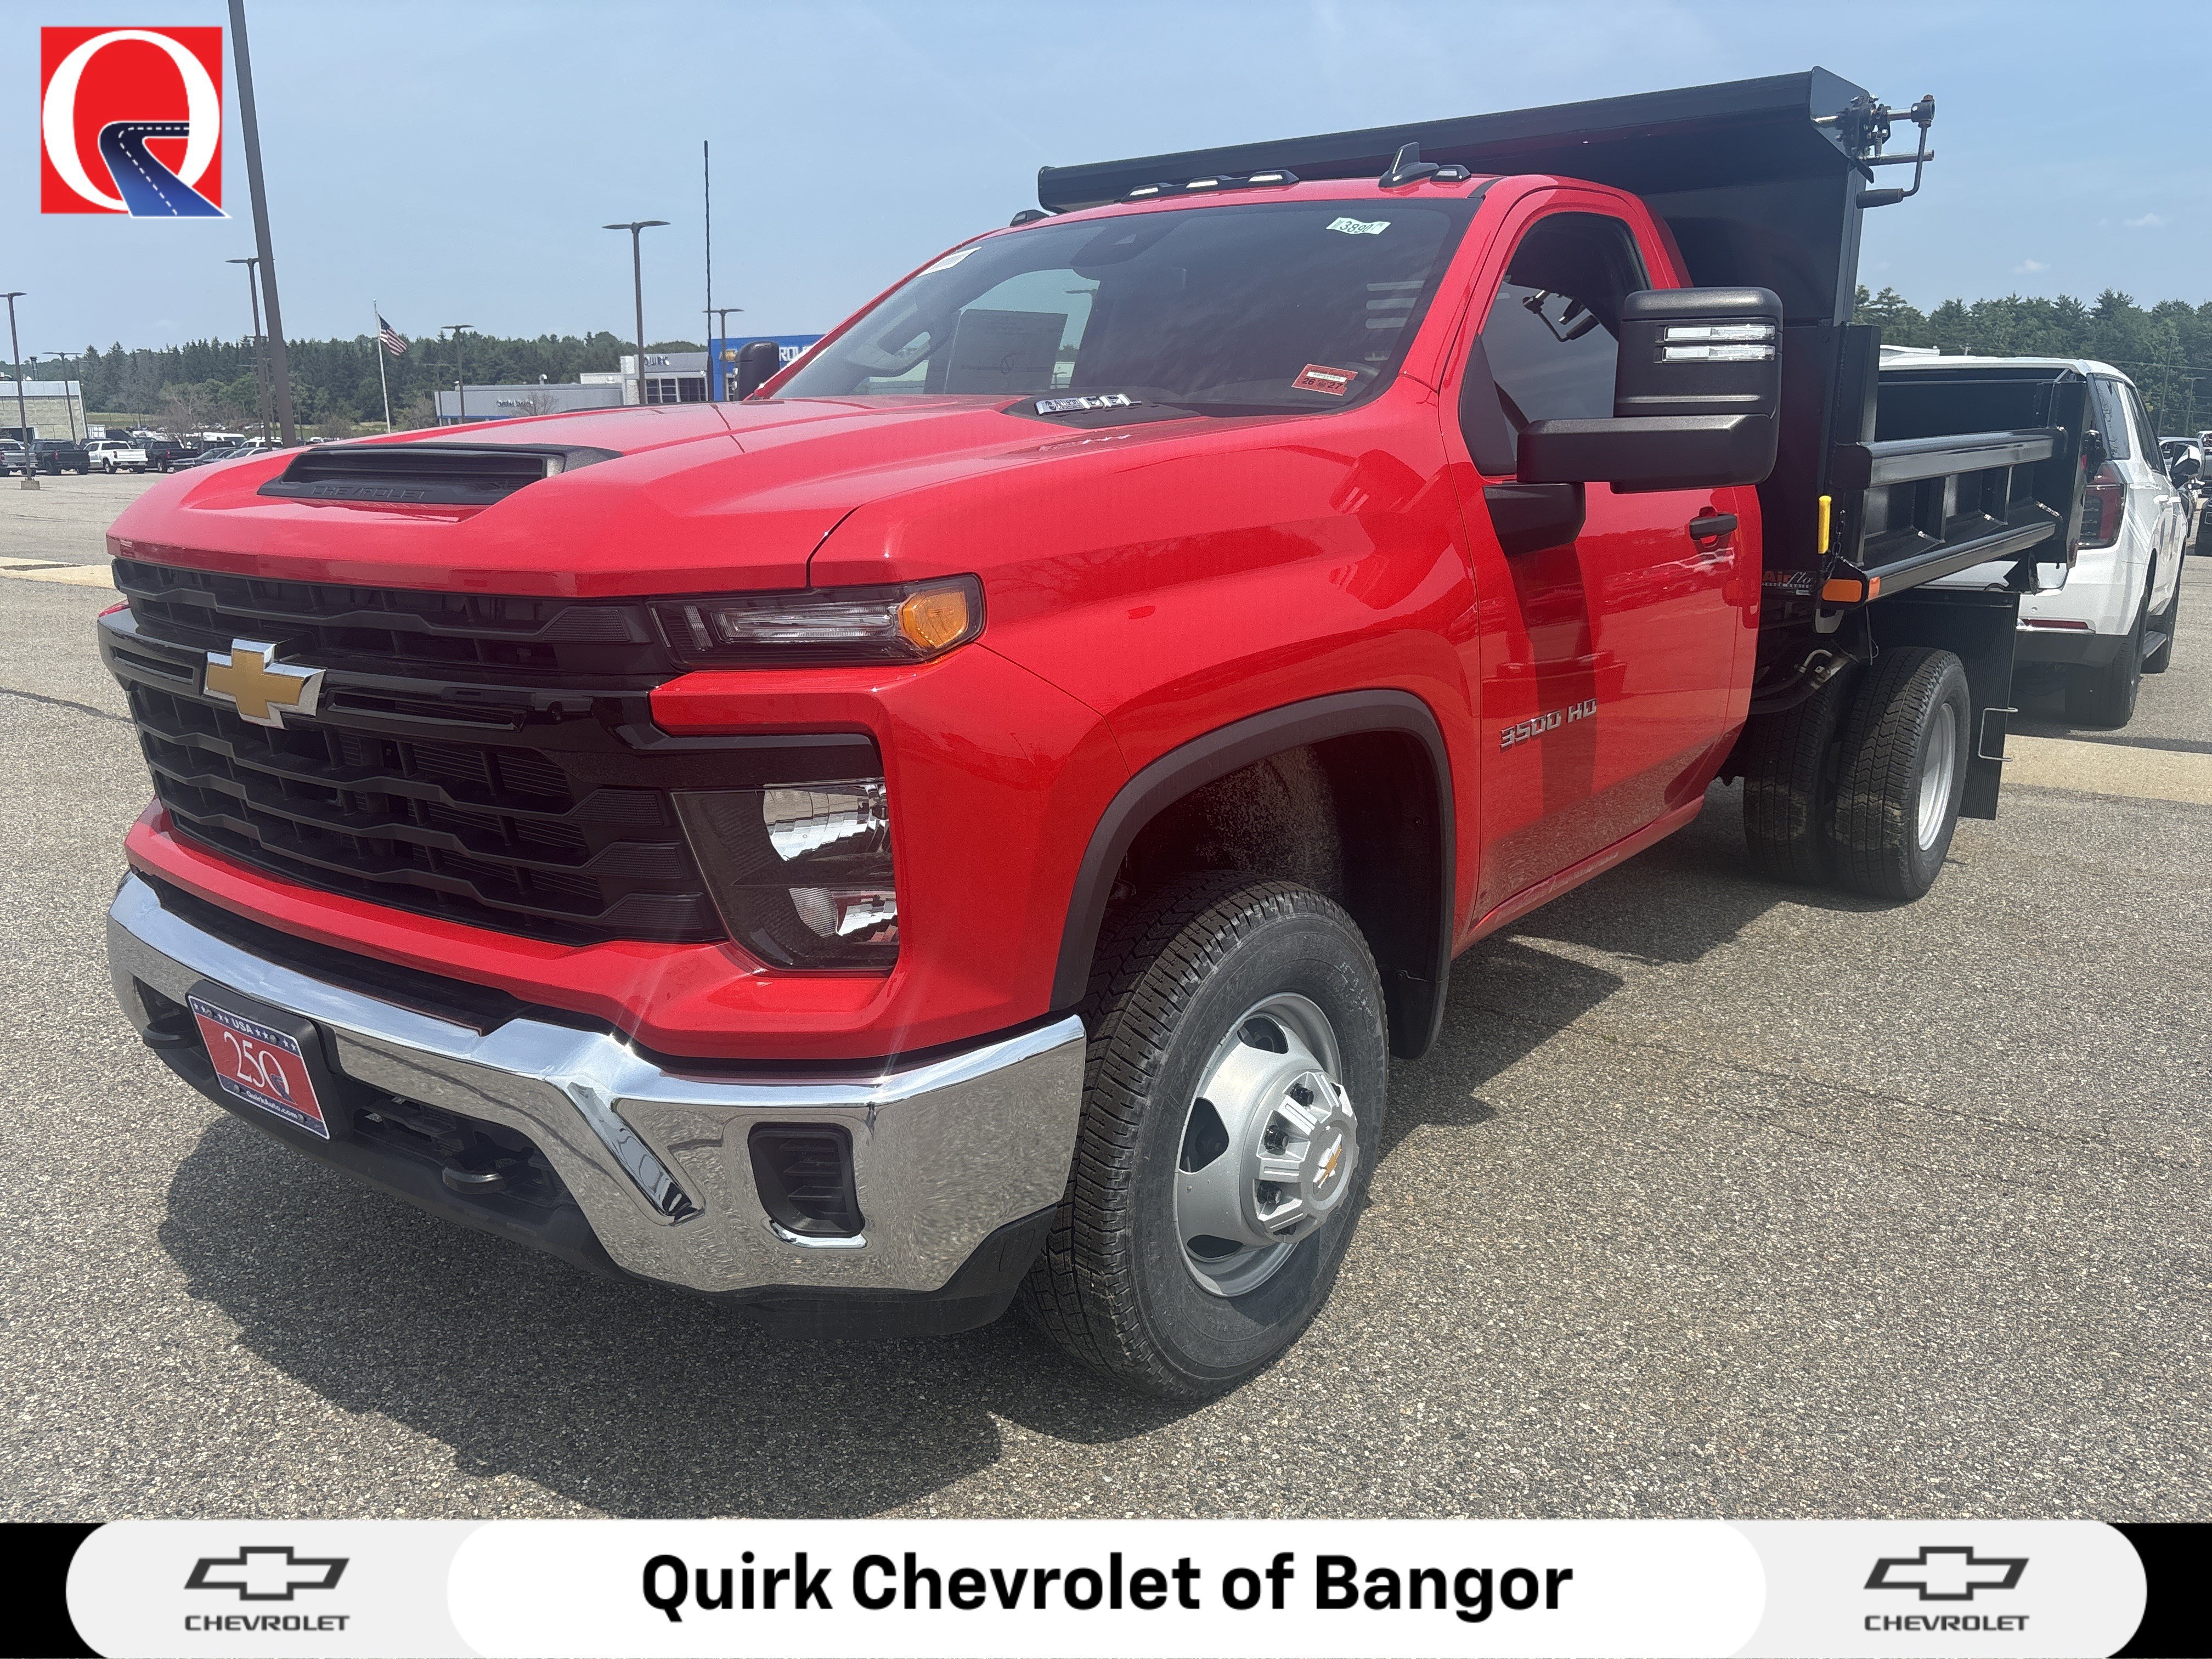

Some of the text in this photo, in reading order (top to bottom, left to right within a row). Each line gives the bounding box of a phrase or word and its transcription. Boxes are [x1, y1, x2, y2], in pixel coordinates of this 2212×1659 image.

[644, 356, 669, 366] QUIRK
[311, 486, 433, 500] CHEVROLET
[1499, 697, 1597, 748] 3500 HD
[232, 1018, 254, 1035] USA
